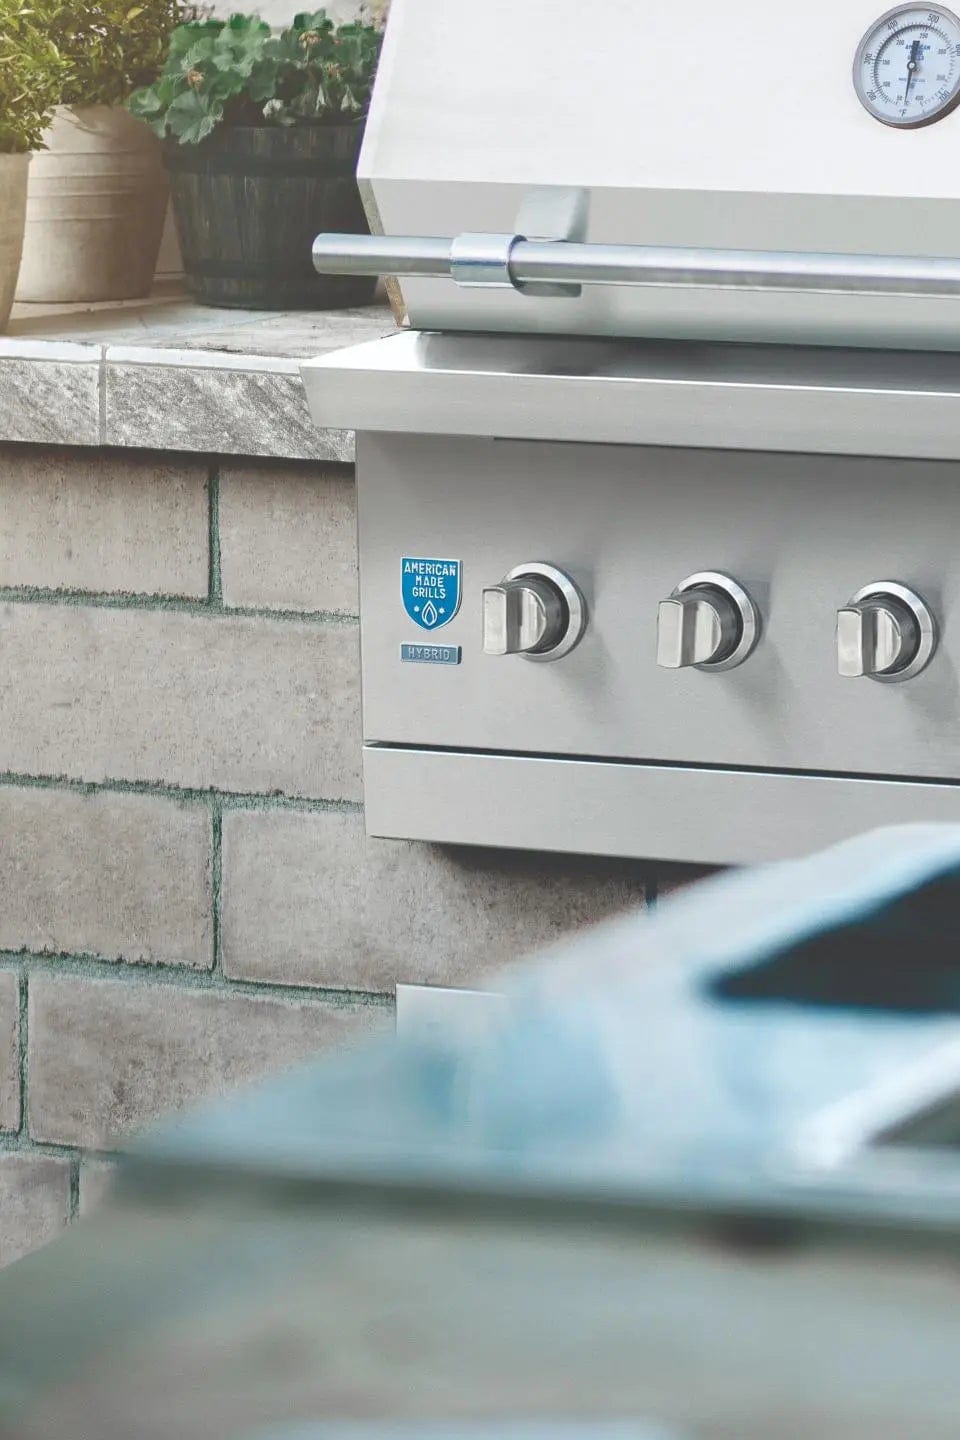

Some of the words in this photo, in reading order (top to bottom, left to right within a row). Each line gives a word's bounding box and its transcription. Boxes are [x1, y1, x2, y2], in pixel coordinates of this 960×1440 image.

[404, 561, 456, 577] AMERICAN
[415, 576, 444, 588] MADE
[412, 587, 446, 599] GRILLS
[408, 647, 450, 661] HYBRID
